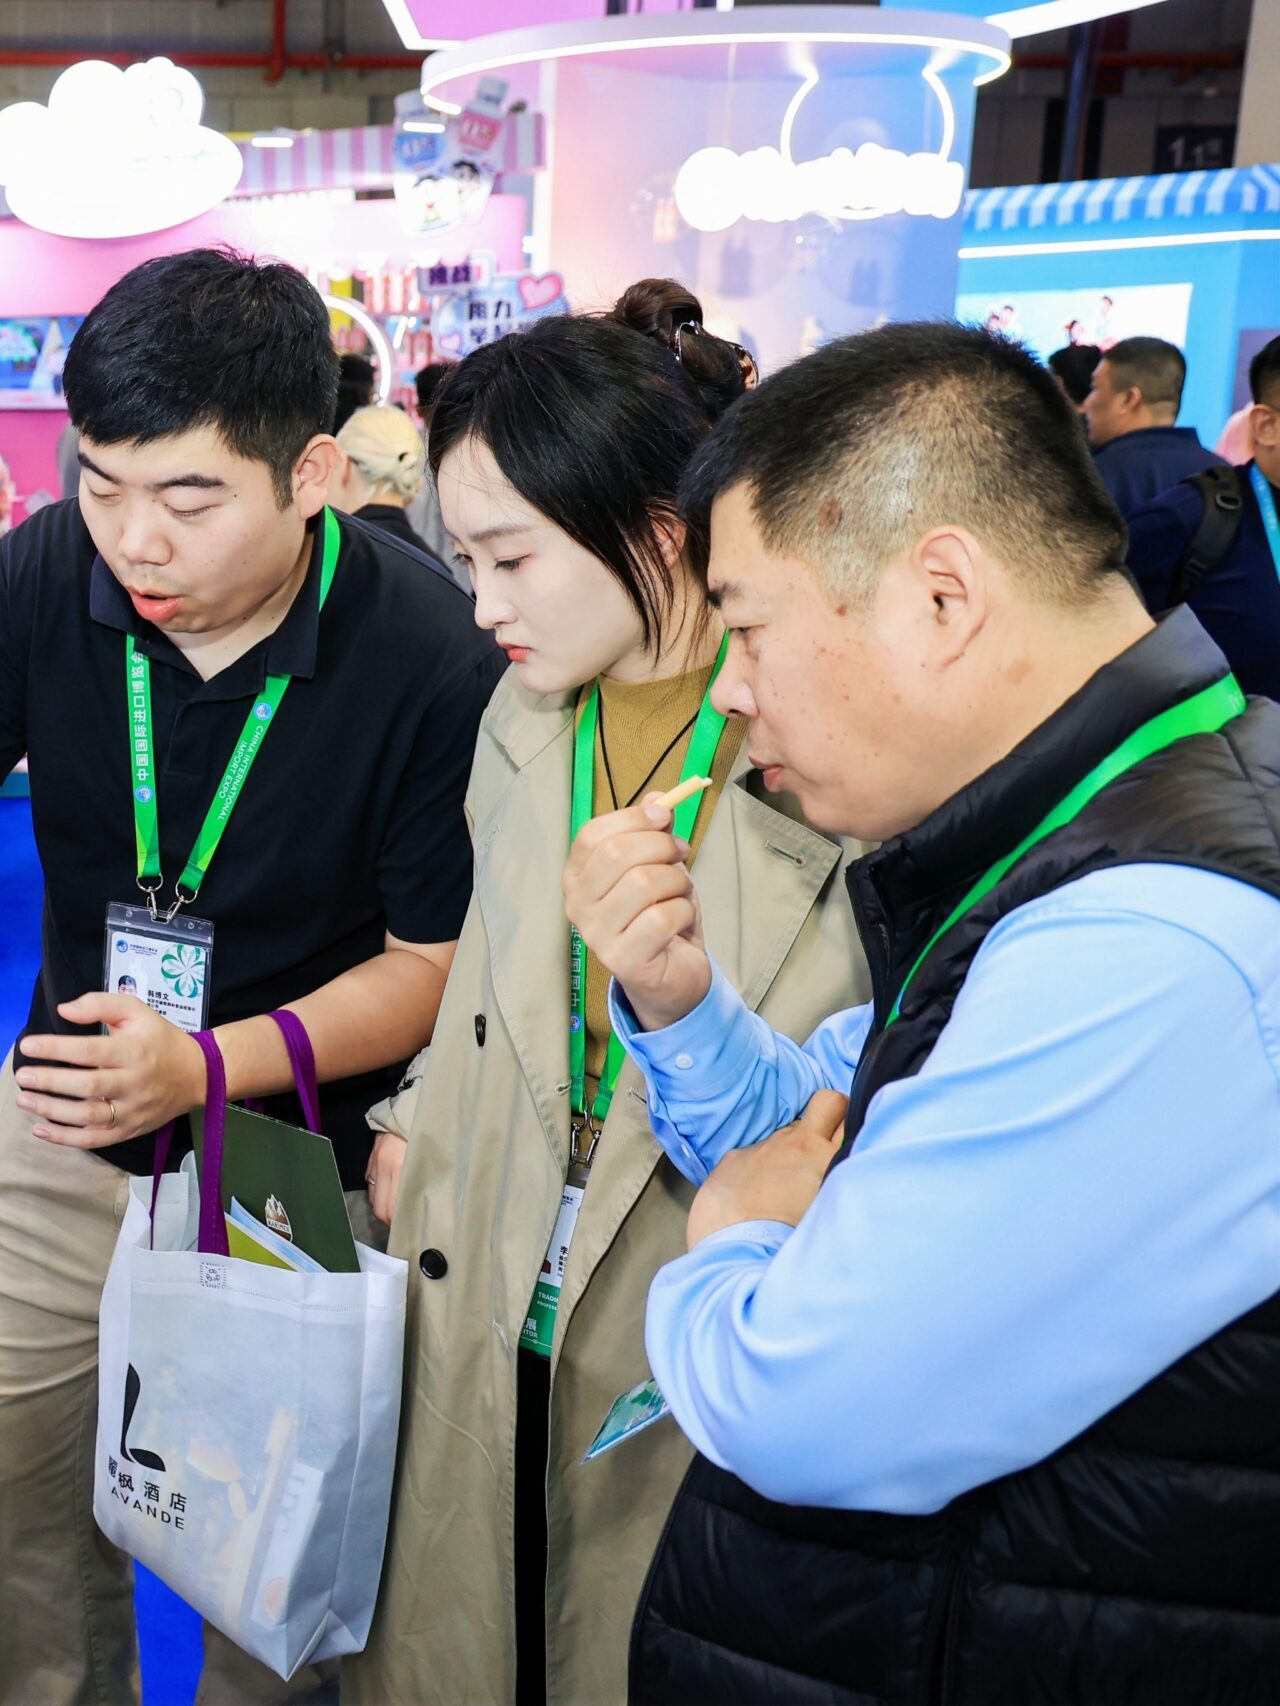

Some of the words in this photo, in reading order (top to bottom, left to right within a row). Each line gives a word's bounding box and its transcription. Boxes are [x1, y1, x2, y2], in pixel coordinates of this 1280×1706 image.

[131, 651, 149, 781] 中国国际进口博览会
[236, 725, 264, 753] CHINA
[230, 740, 248, 774] IMPORT
[217, 755, 251, 820] INTERNATIONAL
[219, 775, 233, 799] EXPO
